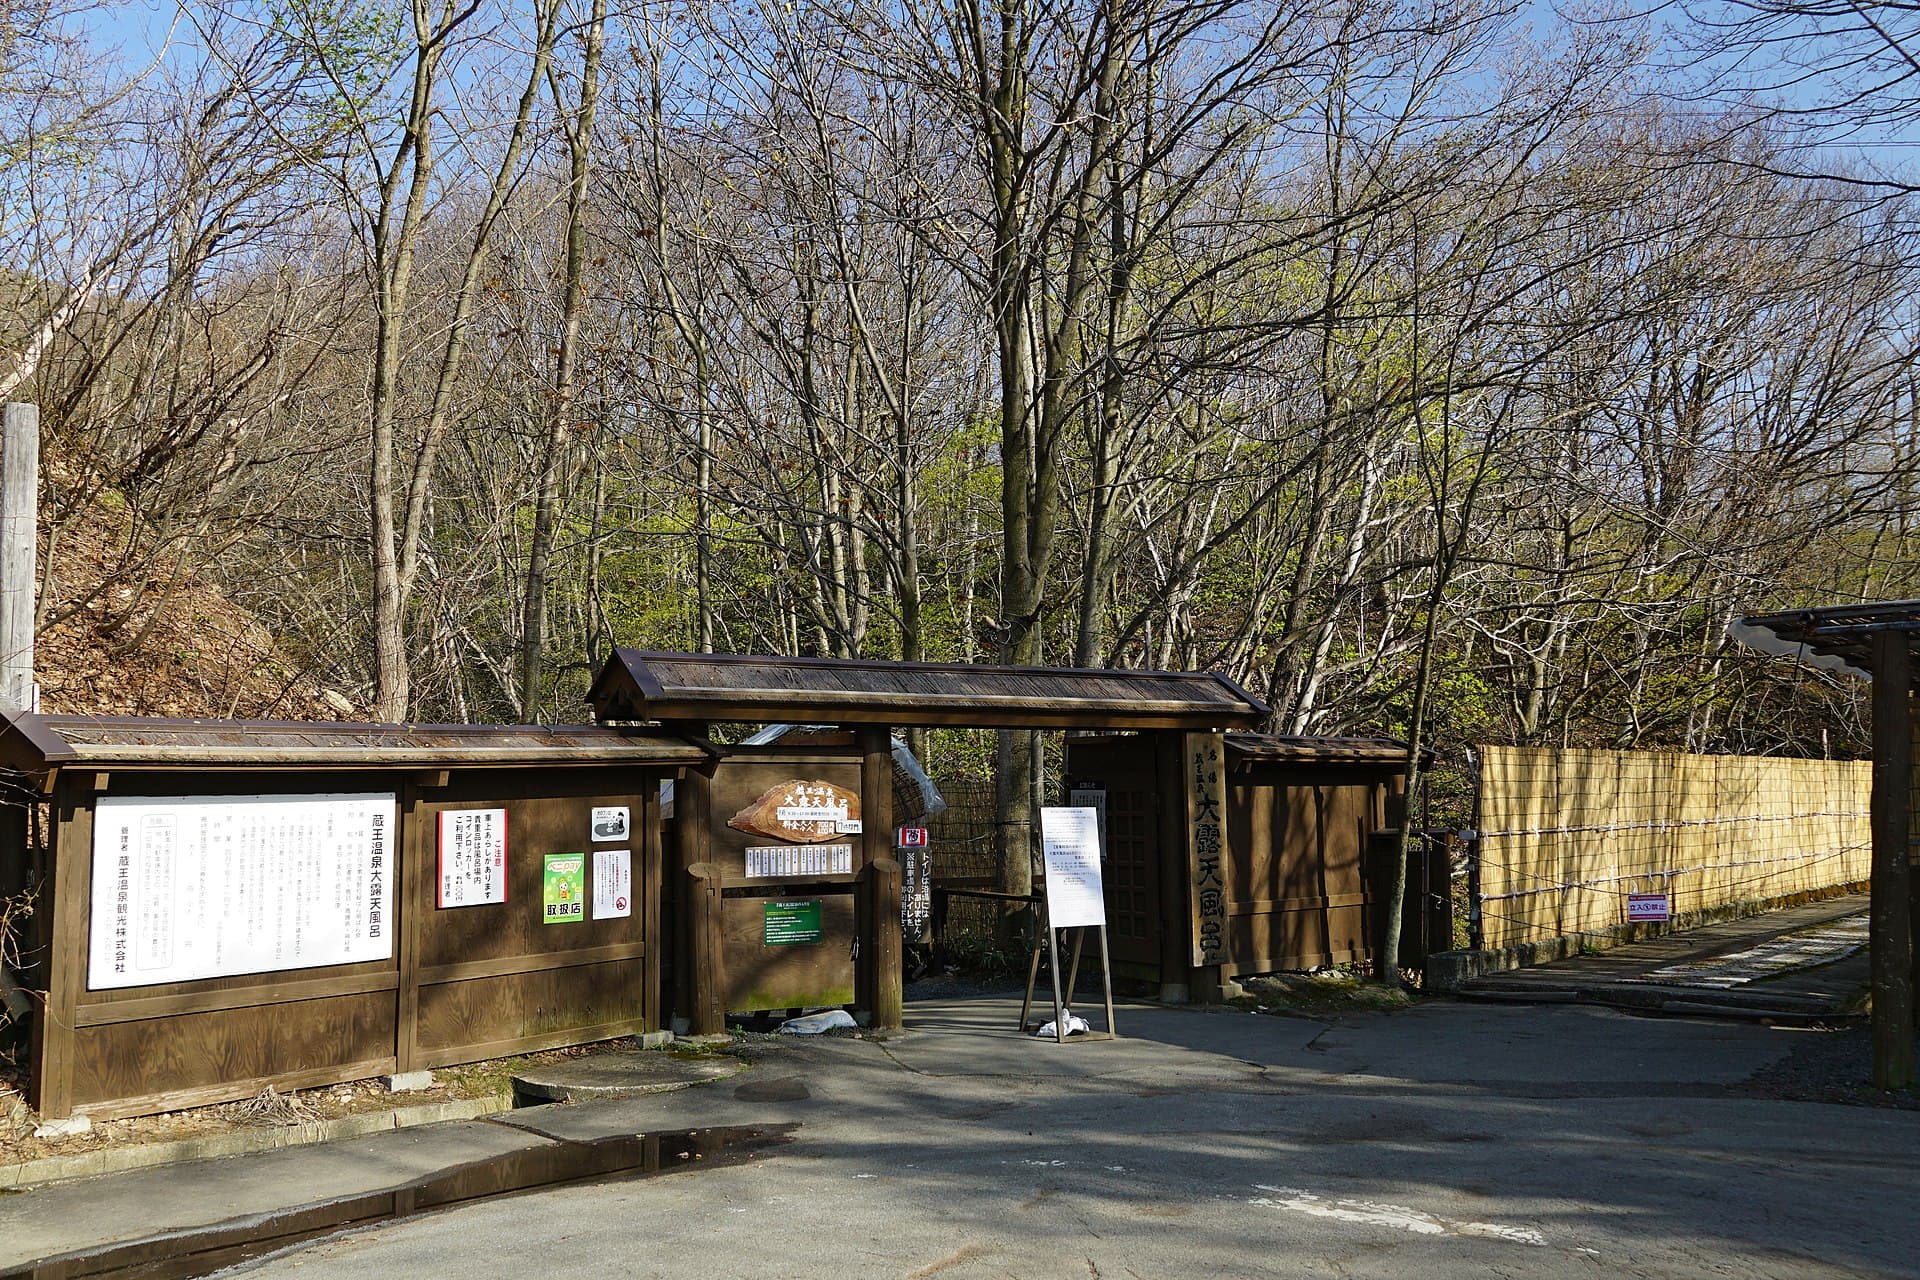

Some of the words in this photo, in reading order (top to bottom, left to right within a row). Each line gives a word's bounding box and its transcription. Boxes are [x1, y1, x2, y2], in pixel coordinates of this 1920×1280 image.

[120, 826, 129, 851] 管理者
[369, 814, 384, 938] 蔵王温泉大露天風呂
[484, 814, 492, 899] 車上あらしがあります
[1195, 794, 1223, 953] 大露天風呂
[115, 856, 130, 974] 蔵王温泉観光株式会社
[547, 903, 581, 915] 取扱店
